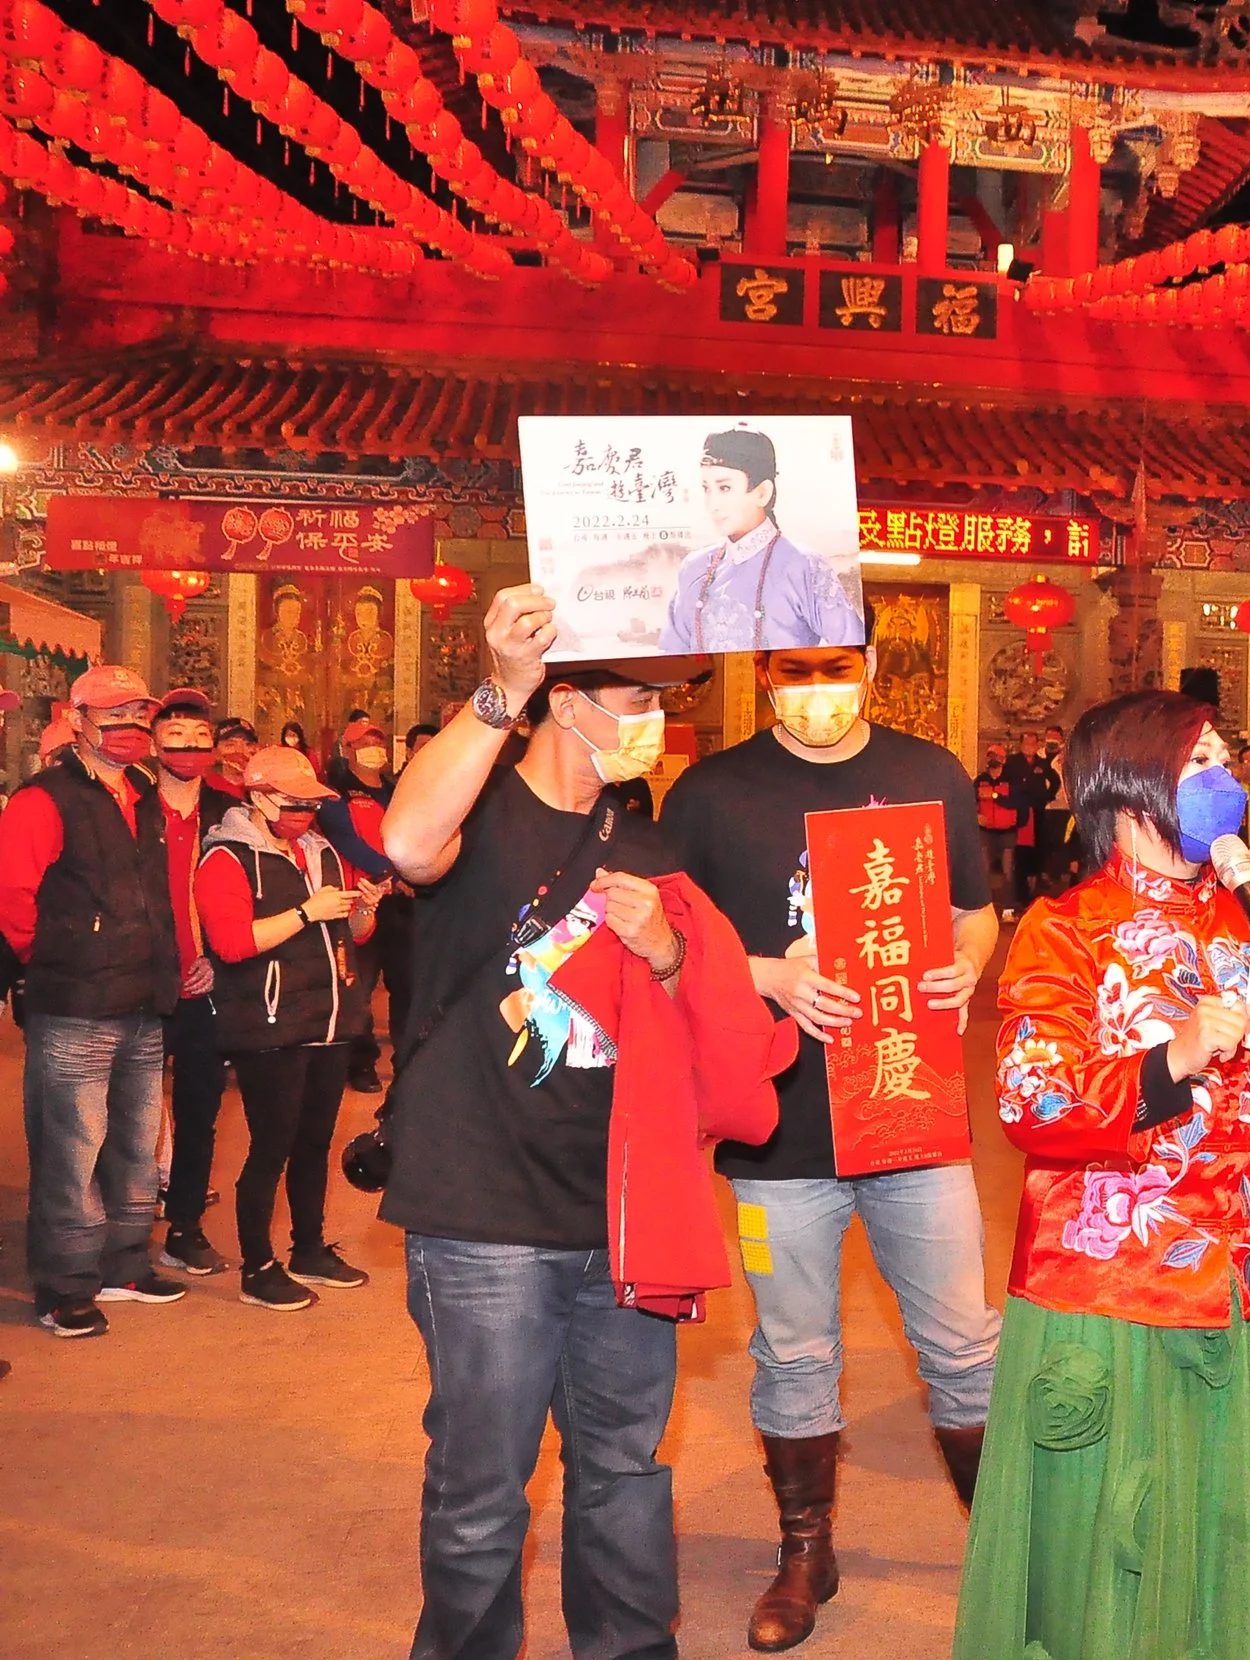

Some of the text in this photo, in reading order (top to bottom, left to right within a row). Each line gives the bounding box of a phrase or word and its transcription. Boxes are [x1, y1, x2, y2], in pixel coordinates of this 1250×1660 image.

[573, 514, 649, 528] 2022.2.24
[599, 807, 615, 842] Canon
[849, 838, 931, 1101] 嘉福同慶
